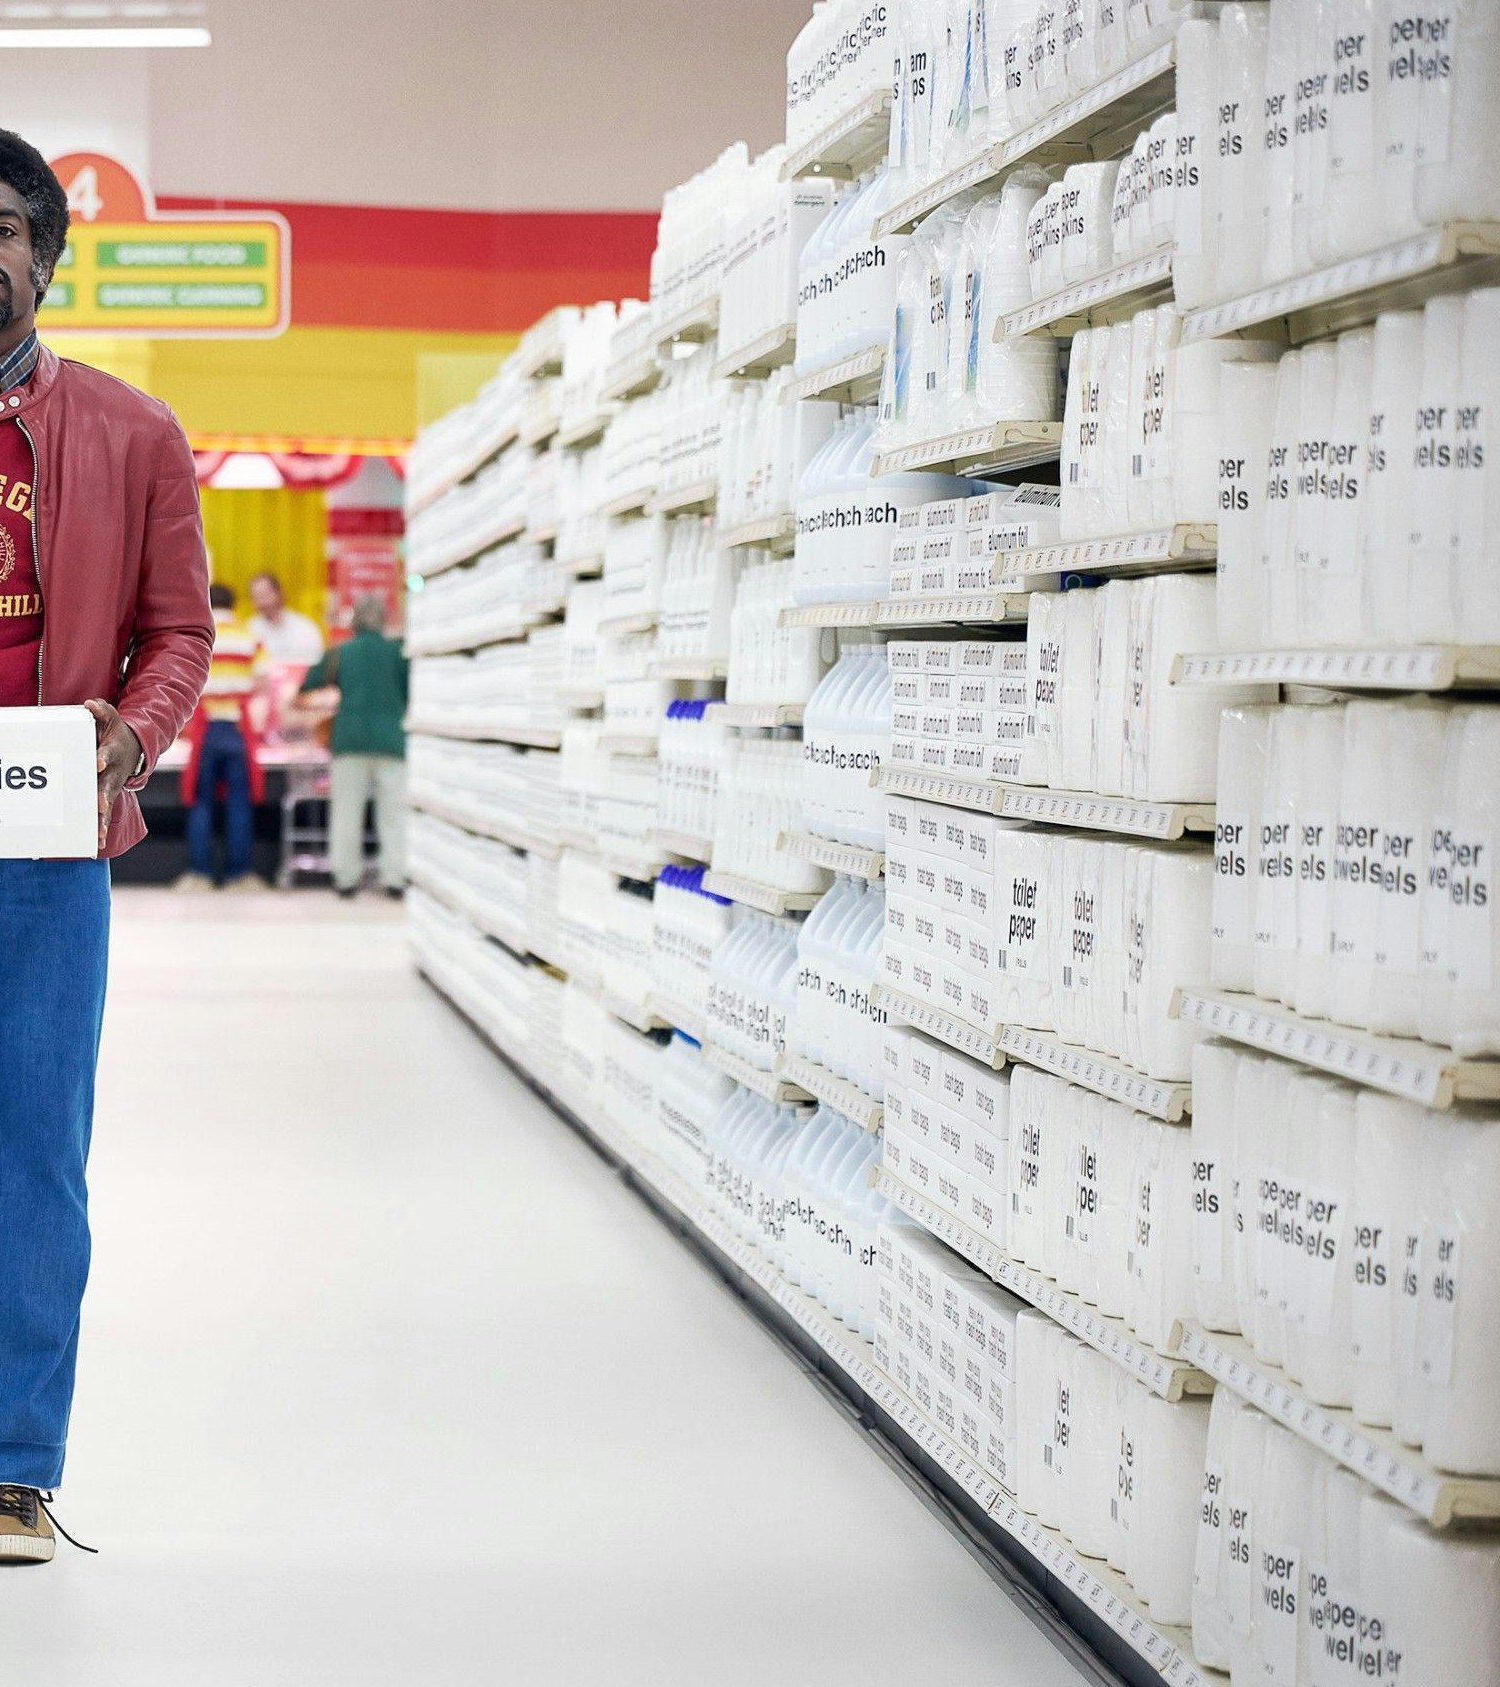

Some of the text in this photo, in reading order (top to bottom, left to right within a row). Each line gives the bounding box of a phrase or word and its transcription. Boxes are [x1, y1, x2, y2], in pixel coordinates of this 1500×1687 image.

[67, 165, 102, 222] 4
[988, 525, 1029, 551] aluminum foil
[1216, 821, 1243, 846] per
[1013, 877, 1038, 909] toilet
[1008, 914, 1037, 946] paper
